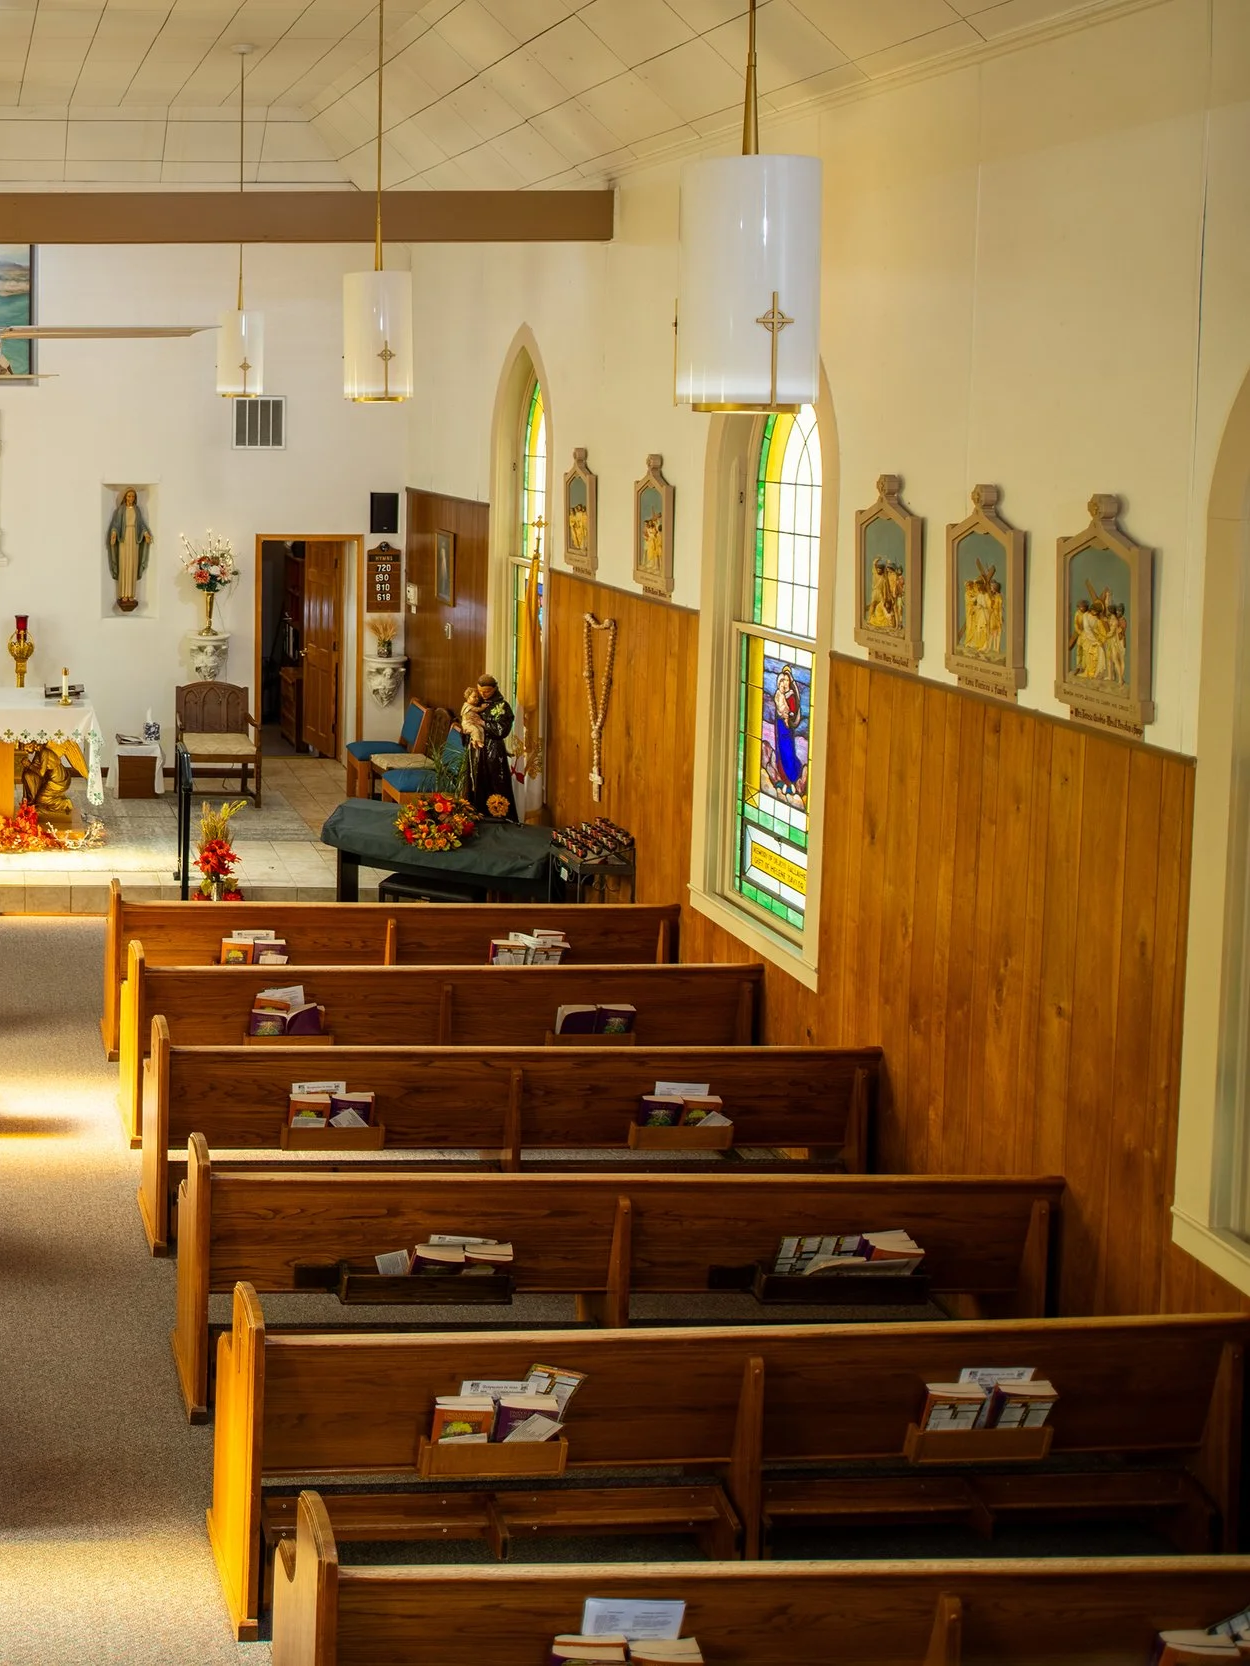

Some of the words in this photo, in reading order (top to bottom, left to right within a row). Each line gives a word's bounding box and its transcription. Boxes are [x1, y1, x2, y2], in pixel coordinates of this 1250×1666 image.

[377, 564, 391, 572] 720
[375, 573, 389, 582] 690
[376, 583, 390, 591] 810
[376, 593, 391, 601] 618
